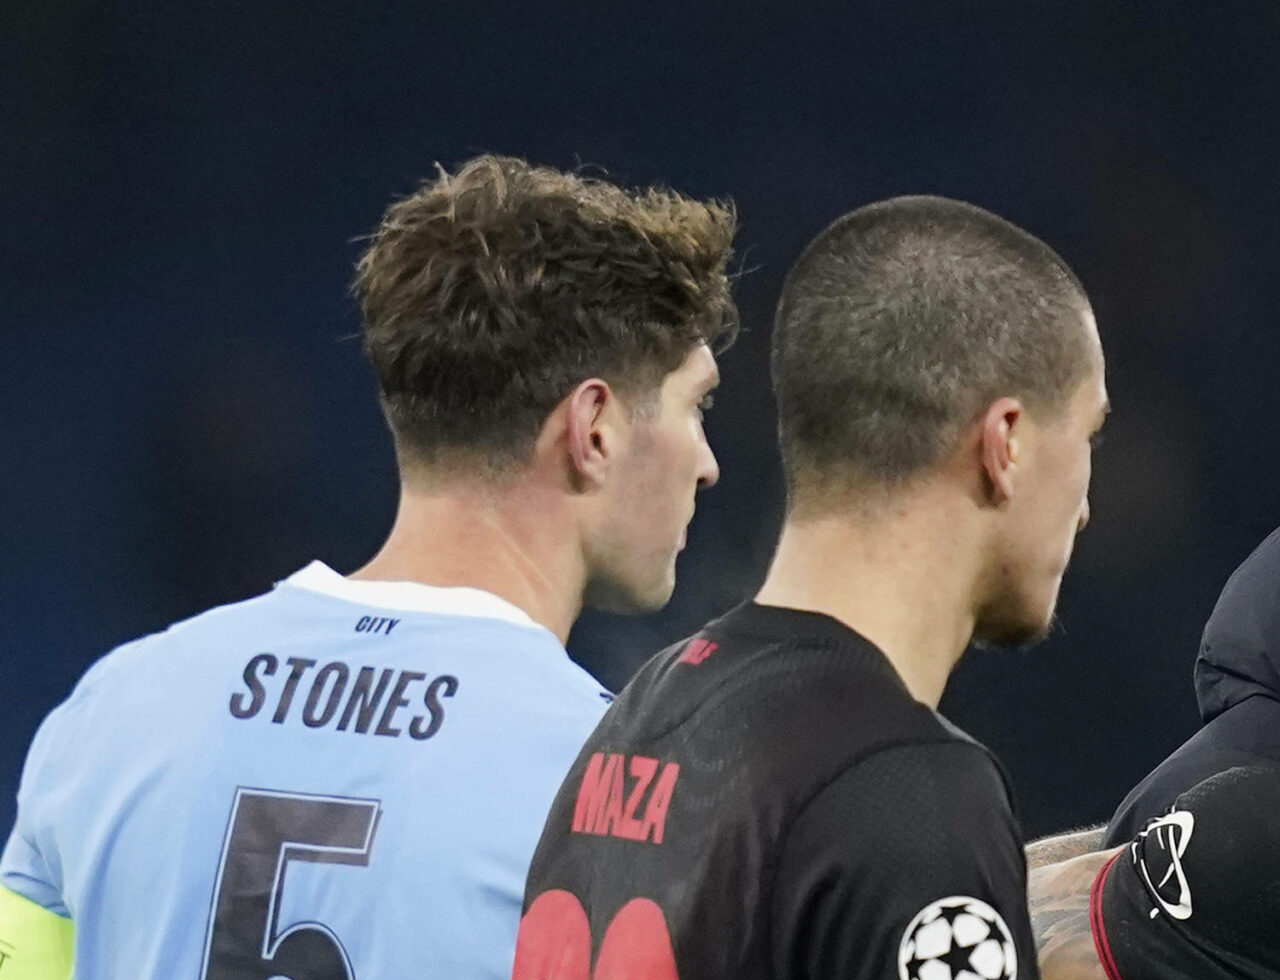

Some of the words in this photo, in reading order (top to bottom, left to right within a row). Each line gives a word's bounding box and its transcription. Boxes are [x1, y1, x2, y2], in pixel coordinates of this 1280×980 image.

[355, 616, 401, 635] CITY
[229, 653, 459, 741] STONES
[571, 752, 680, 845] MAZA
